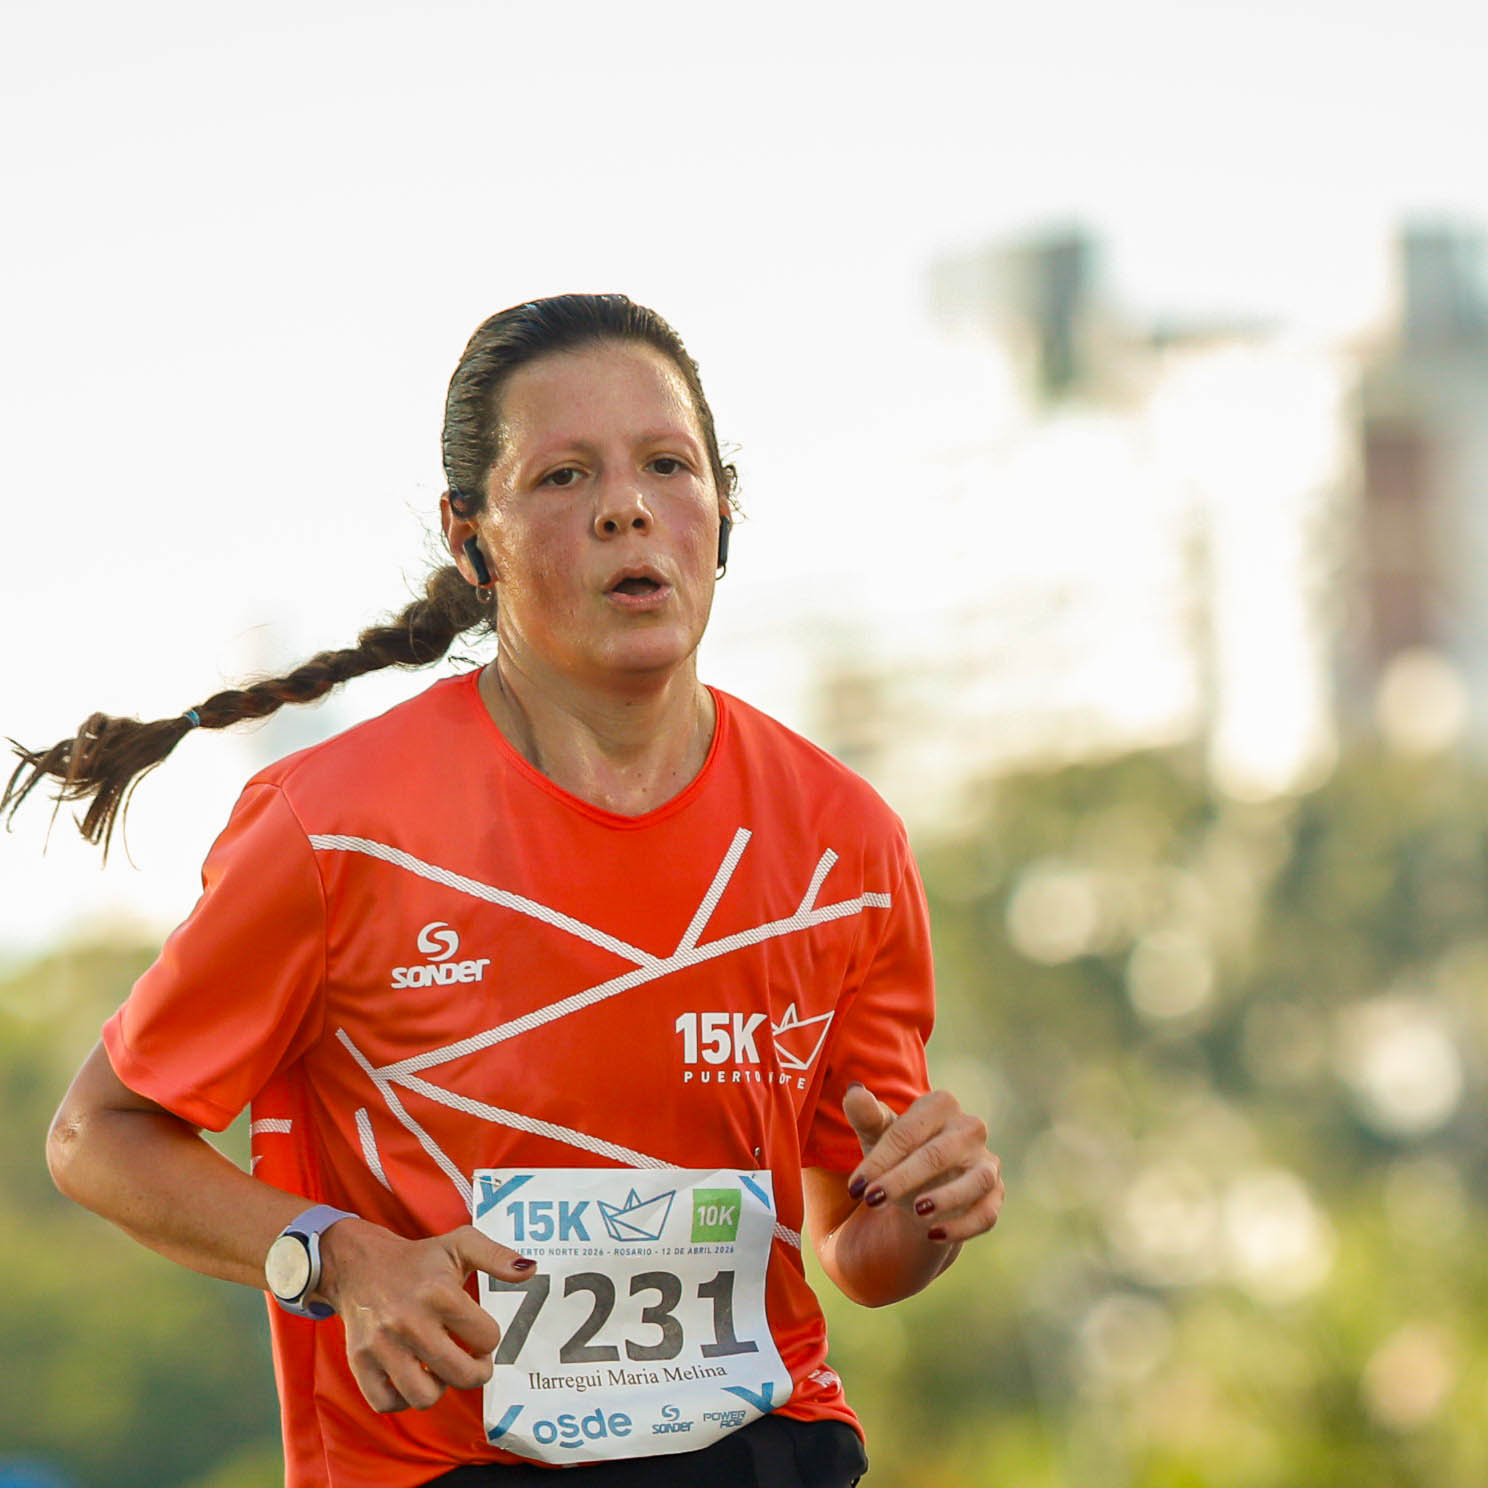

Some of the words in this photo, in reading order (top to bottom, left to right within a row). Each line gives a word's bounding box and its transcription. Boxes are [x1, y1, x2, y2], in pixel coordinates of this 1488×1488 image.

[675, 1012, 768, 1065] 15K
[684, 1070, 761, 1083] PUERTO
[506, 1200, 591, 1242] 15K
[697, 1205, 736, 1227] 10K
[548, 1247, 579, 1257] NORTE
[614, 1247, 653, 1256] ROSARIO
[687, 1246, 712, 1255] ABRIL
[488, 1270, 759, 1365] 7231
[527, 1369, 603, 1393] Ilarregui
[607, 1368, 660, 1387] Maria
[661, 1364, 729, 1383] Melina
[532, 1407, 633, 1446] osde
[703, 1410, 747, 1422] POWER
